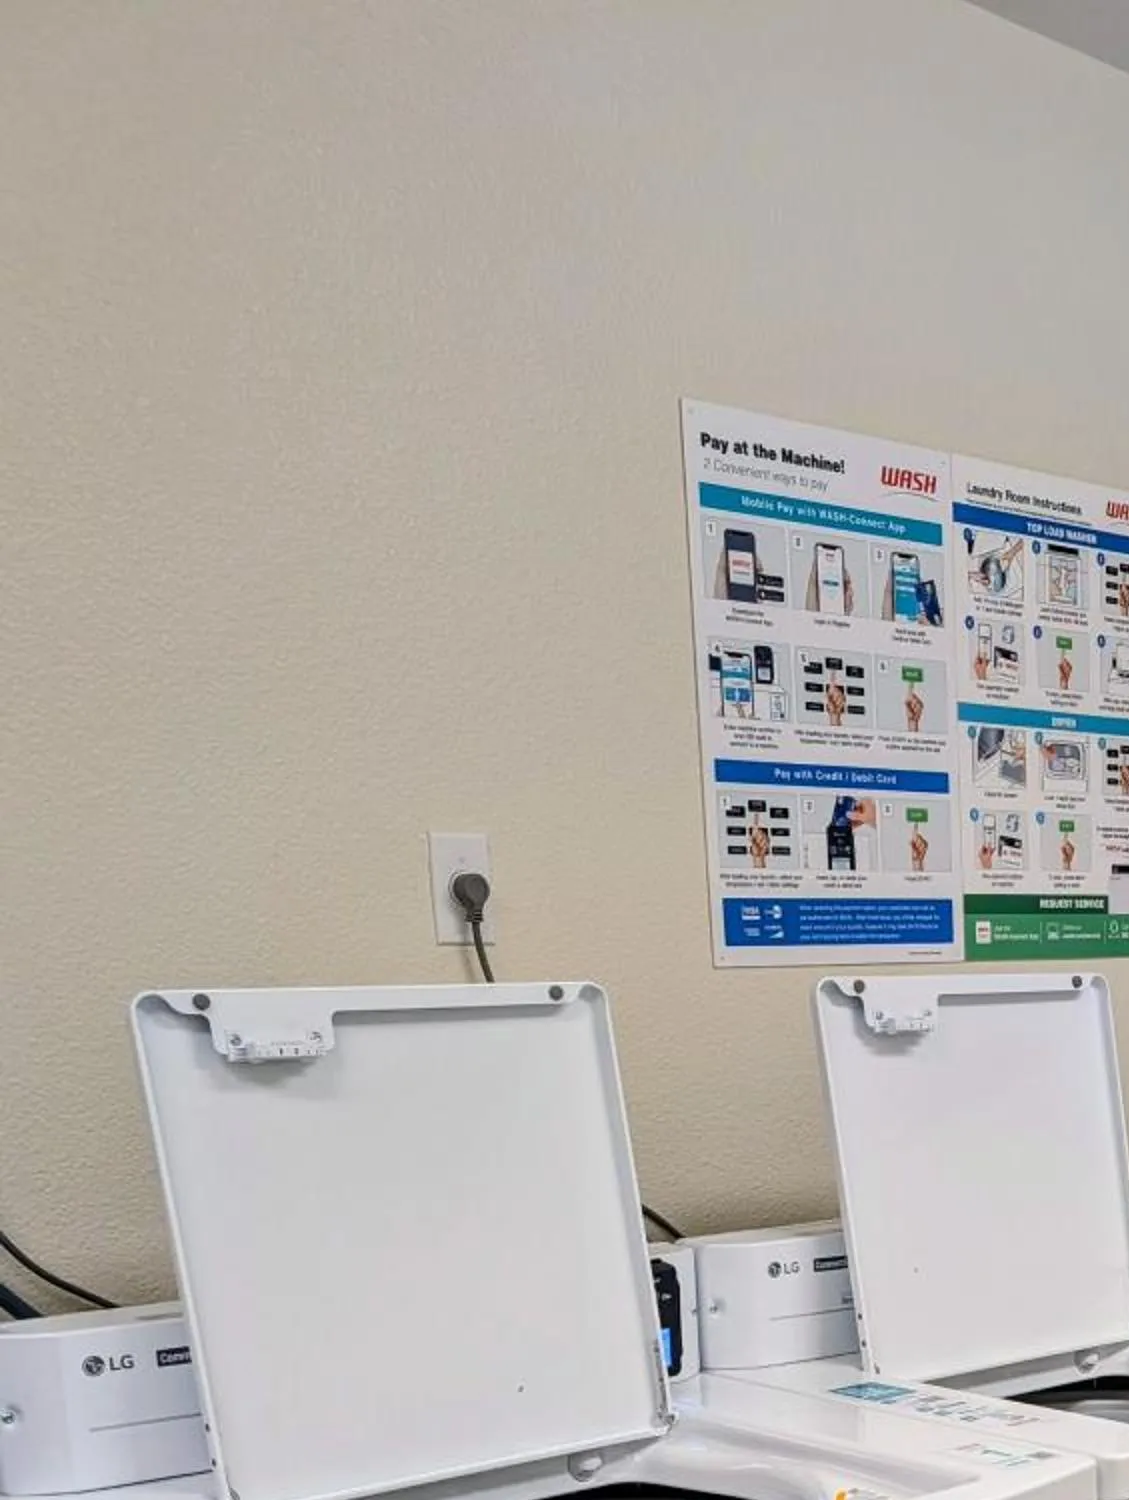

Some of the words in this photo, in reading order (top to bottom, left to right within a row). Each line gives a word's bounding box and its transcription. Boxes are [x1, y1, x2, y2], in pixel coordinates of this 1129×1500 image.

[700, 432, 729, 454] Pay
[733, 441, 749, 456] at
[753, 443, 777, 460] the
[781, 447, 846, 474] Machine!
[704, 458, 711, 469] 2
[713, 459, 771, 480] Convenient
[772, 473, 797, 488] ways
[800, 476, 809, 488] to
[811, 480, 830, 493] pay
[881, 466, 937, 494] WASH
[967, 482, 1003, 501] Laundry
[1005, 489, 1030, 505] Room
[1032, 496, 1082, 516] Instructions
[741, 495, 775, 512] Mobile
[777, 502, 795, 516] Pay
[797, 504, 817, 519] with
[888, 521, 906, 534] App
[1026, 522, 1043, 533] TOP
[774, 768, 791, 781] Pay
[794, 769, 813, 781] with
[815, 770, 842, 782] Credit
[851, 772, 875, 783] Debit
[876, 773, 897, 785] Card
[783, 1261, 800, 1274] LG
[108, 1354, 135, 1371] LG
